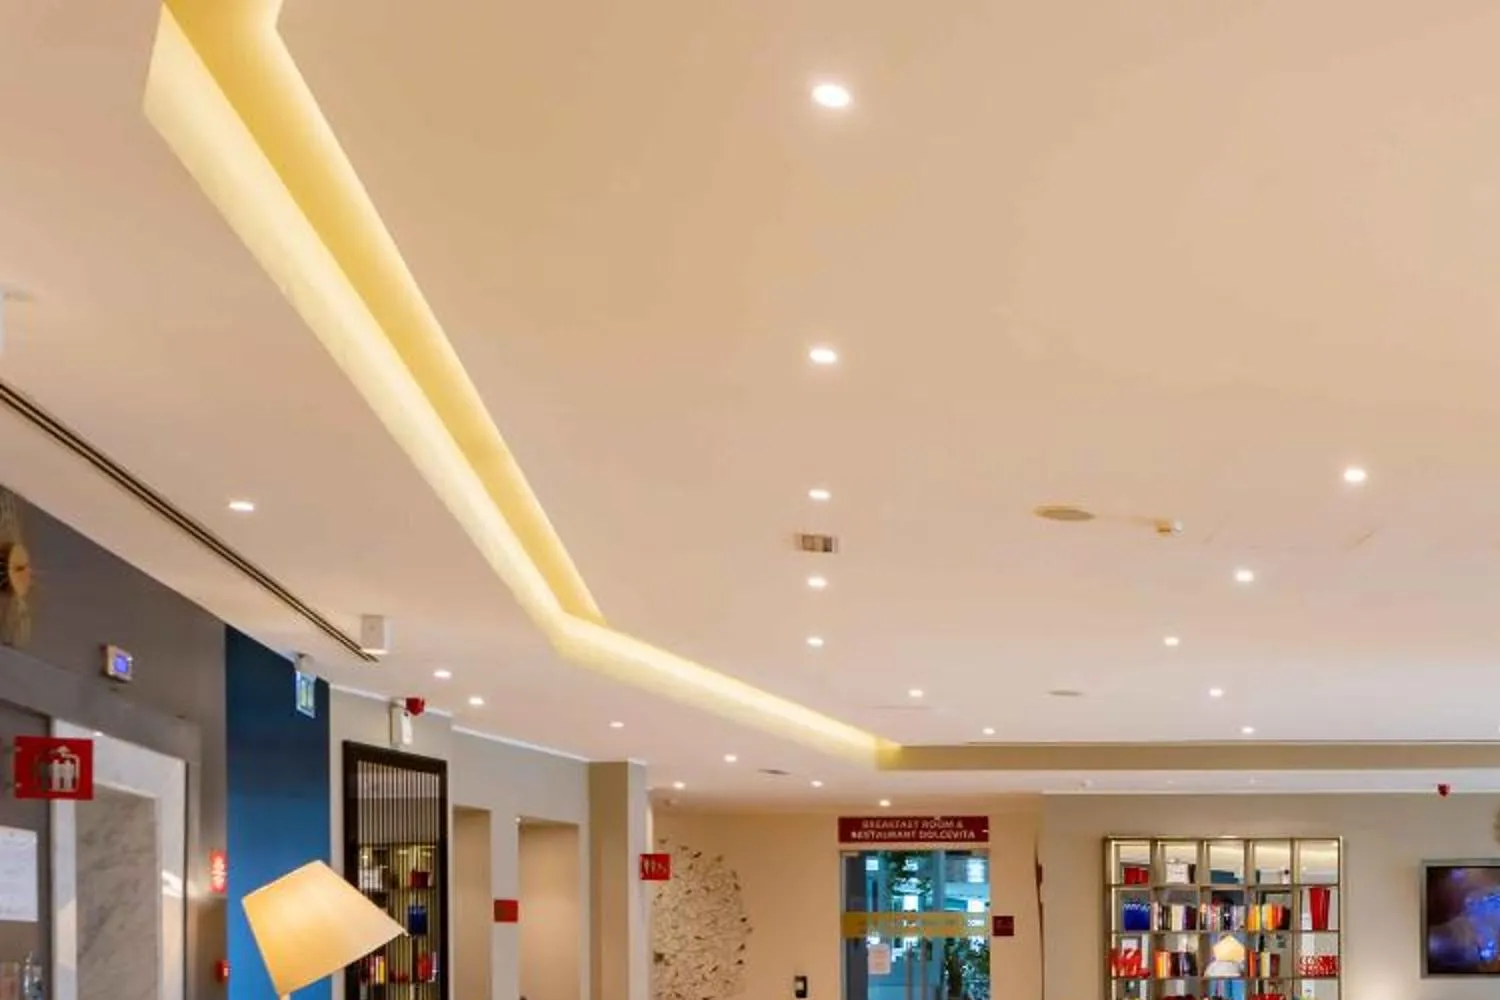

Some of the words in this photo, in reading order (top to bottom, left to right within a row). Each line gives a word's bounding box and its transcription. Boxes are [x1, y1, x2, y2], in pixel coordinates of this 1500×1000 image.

[862, 819, 919, 829] BREAKFAST
[921, 819, 954, 829] ROOM
[851, 830, 915, 840] RESTAURANT
[919, 830, 976, 840] DOLCEVITA
